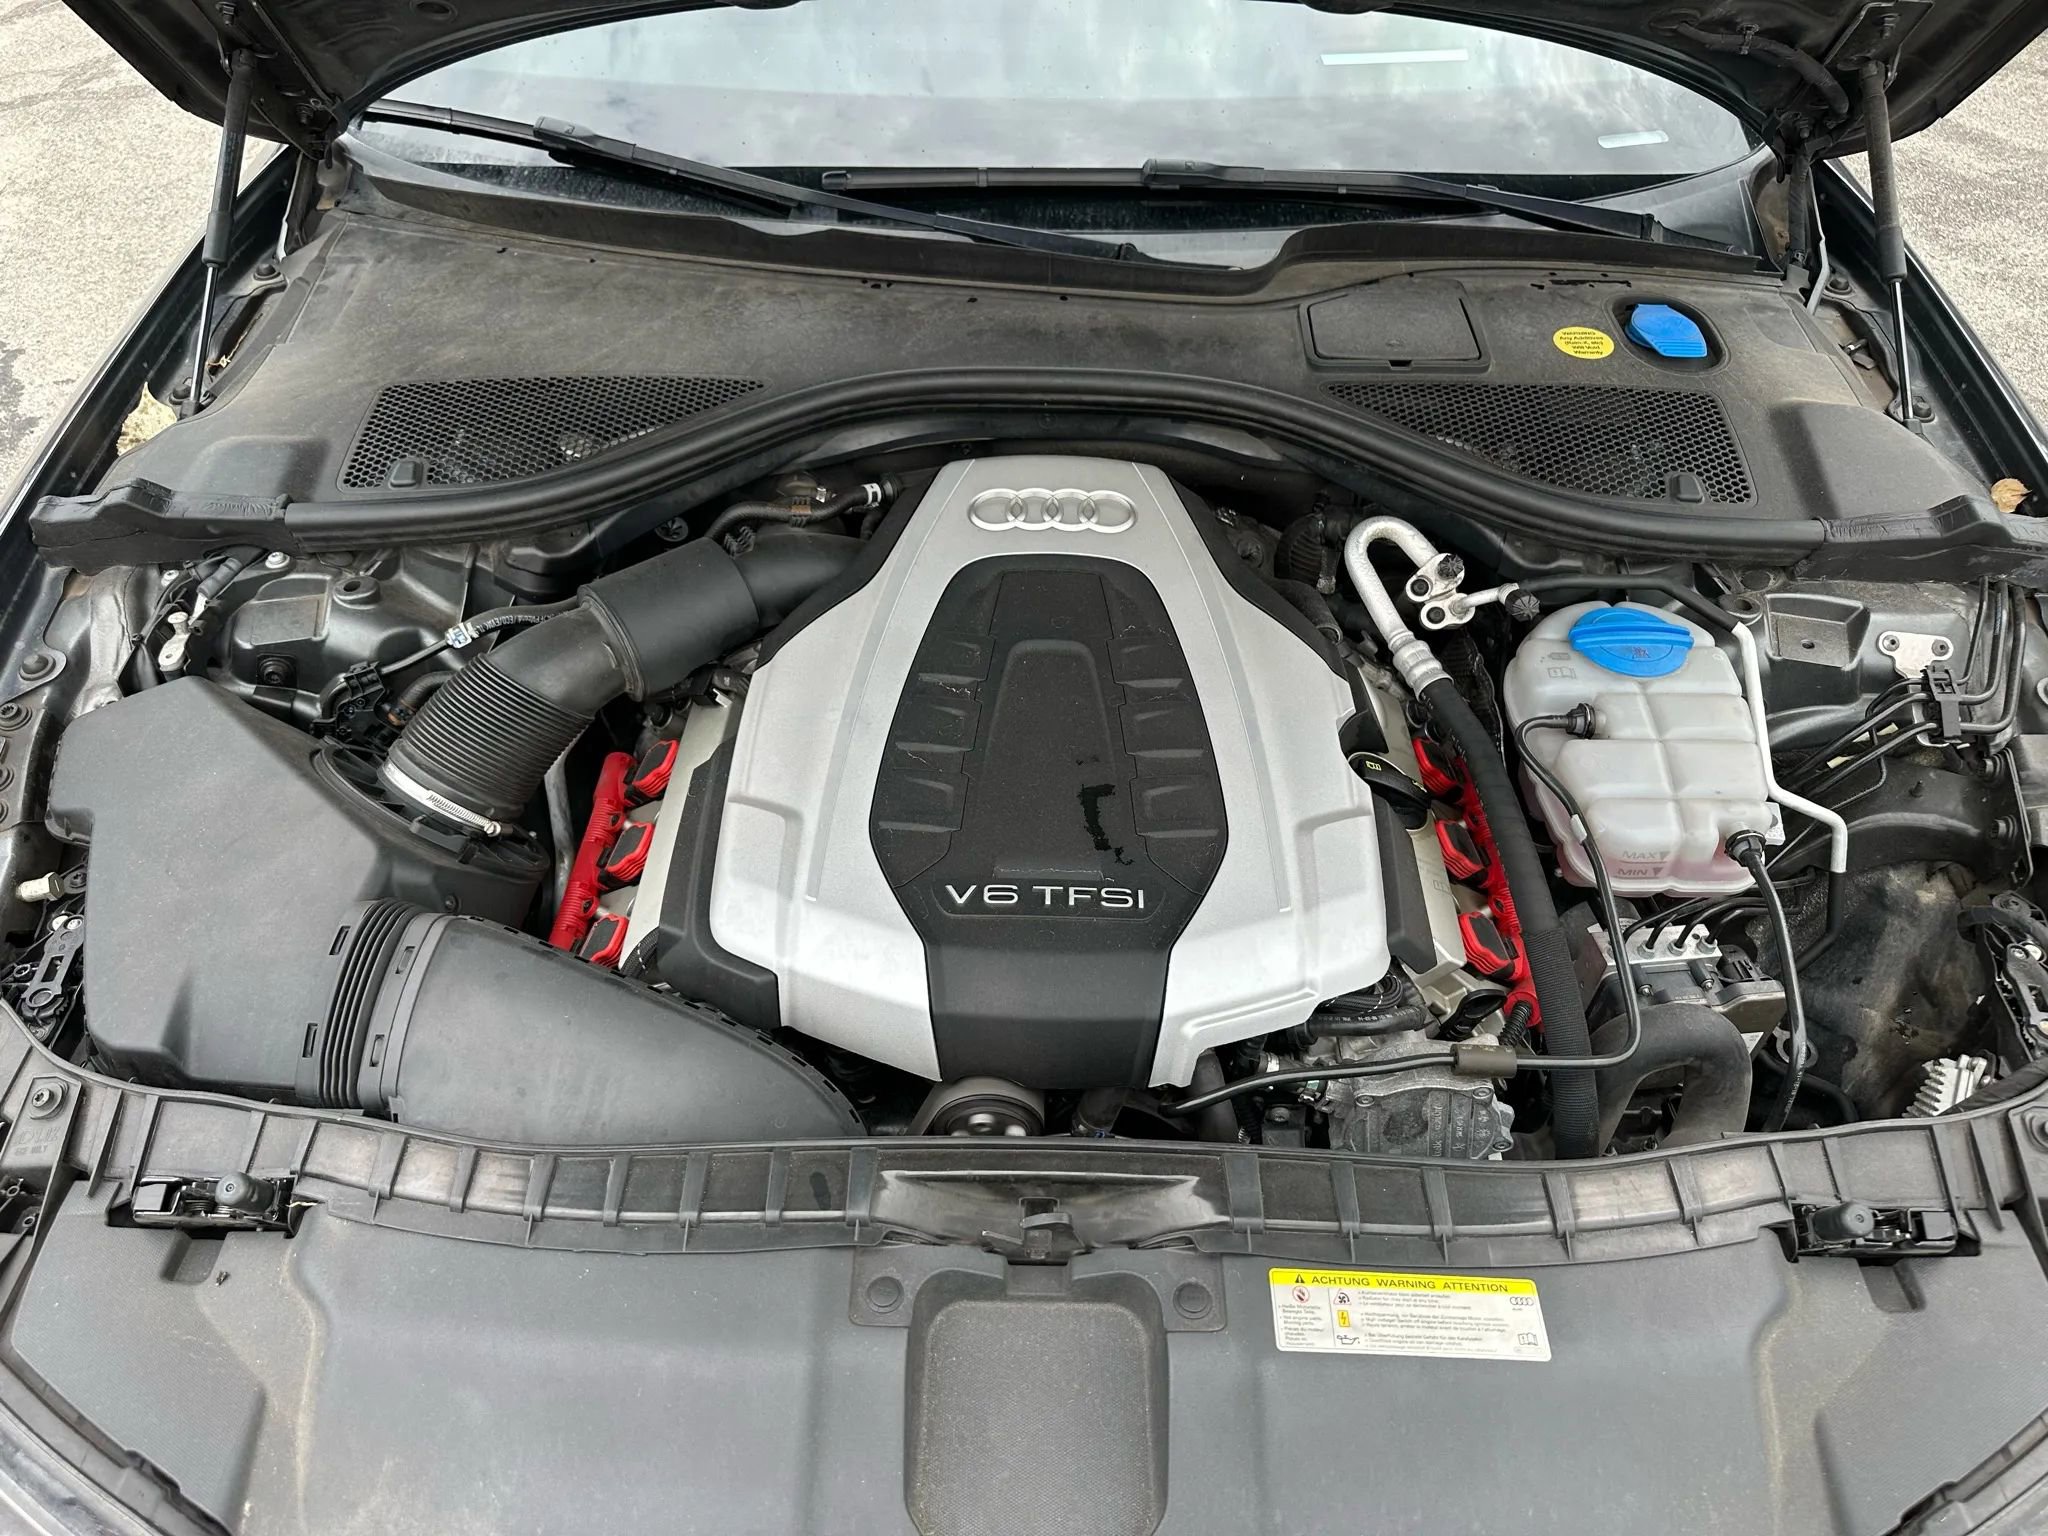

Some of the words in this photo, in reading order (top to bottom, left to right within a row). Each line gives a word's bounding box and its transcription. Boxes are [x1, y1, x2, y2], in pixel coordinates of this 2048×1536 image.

[1622, 850, 1657, 859] MAX
[1617, 868, 1648, 876] MIN
[945, 884, 1019, 904] V6
[1032, 885, 1144, 909] TFSI
[1311, 1275, 1370, 1287] ACHTUNG
[1376, 1279, 1436, 1289] WARNING
[1443, 1281, 1508, 1292] ATTENTION
